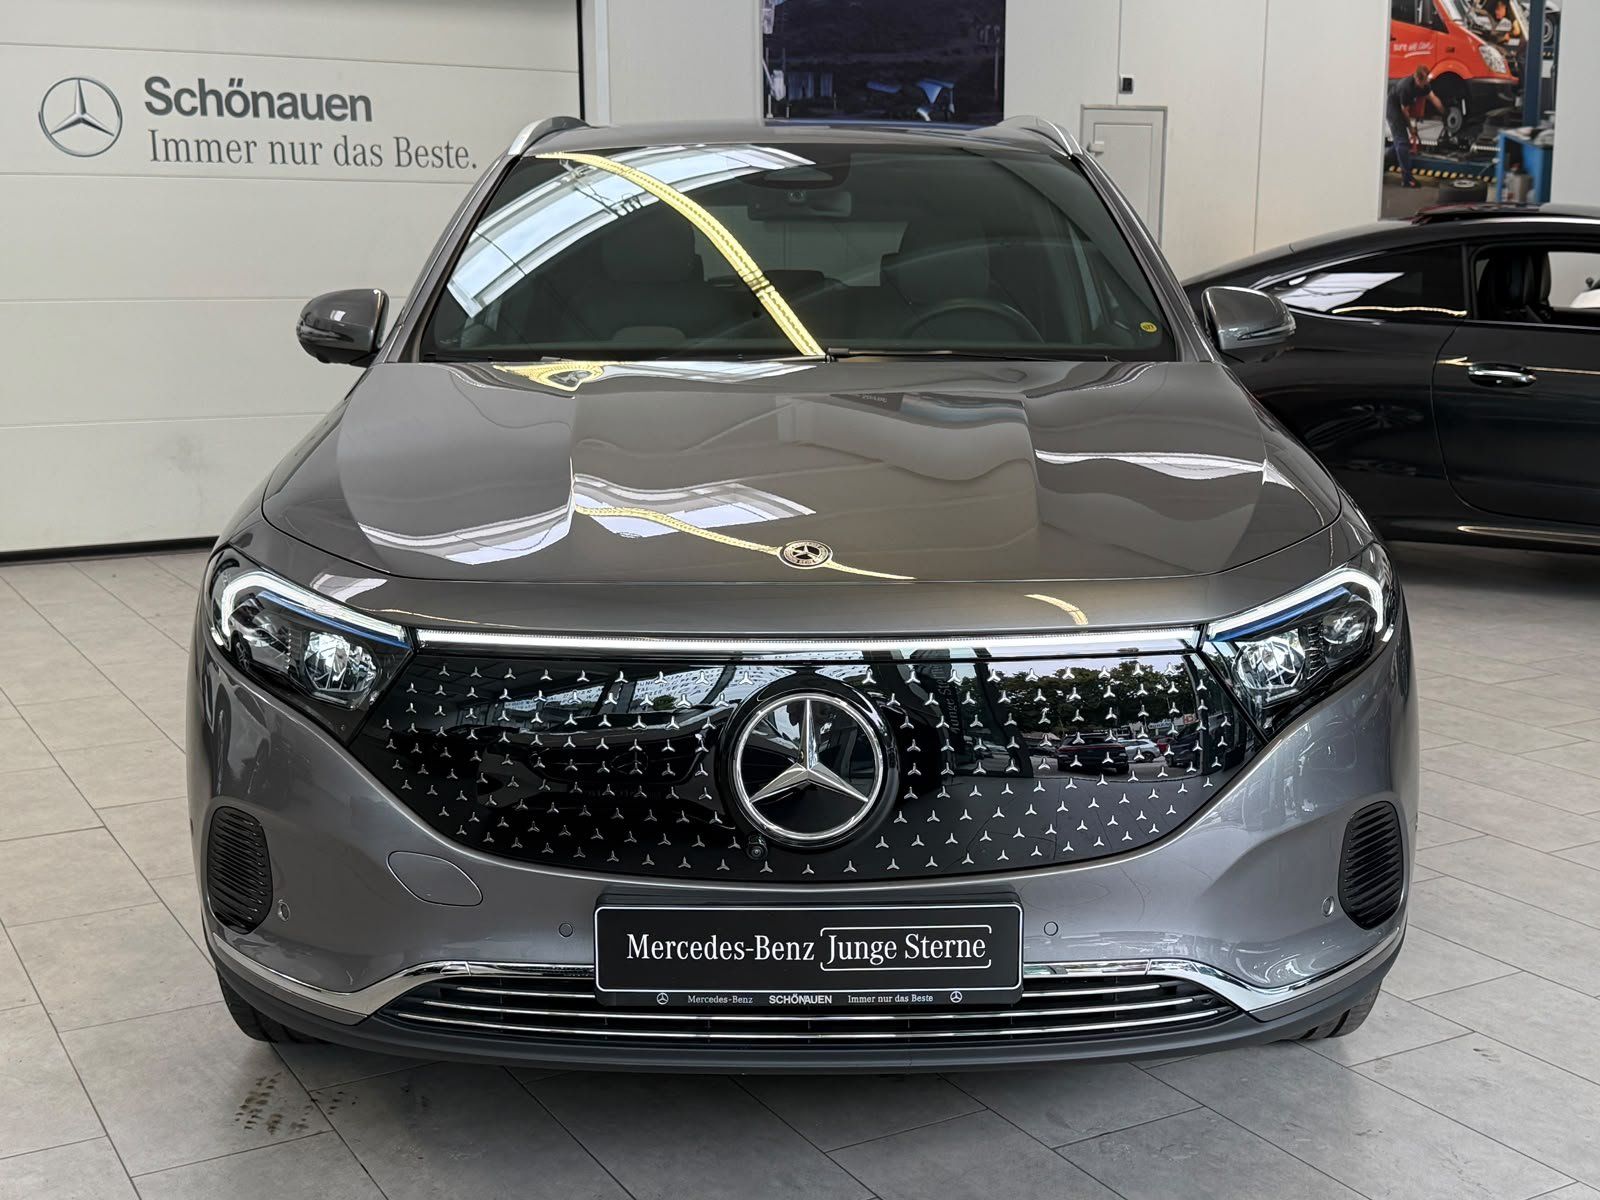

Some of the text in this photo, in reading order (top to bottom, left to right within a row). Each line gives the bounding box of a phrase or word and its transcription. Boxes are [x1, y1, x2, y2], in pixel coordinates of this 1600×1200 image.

[144, 76, 373, 122] Schönauen
[148, 129, 478, 169] Immer nur das Beste.
[626, 933, 986, 965] Mercedes-Benz Junge Sterne
[687, 994, 754, 1004] Mercedes-Benz
[769, 994, 832, 1004] SCHÖNAUEN
[847, 995, 876, 1004] Immer
[895, 994, 909, 1003] das
[911, 994, 934, 1003] Beste
